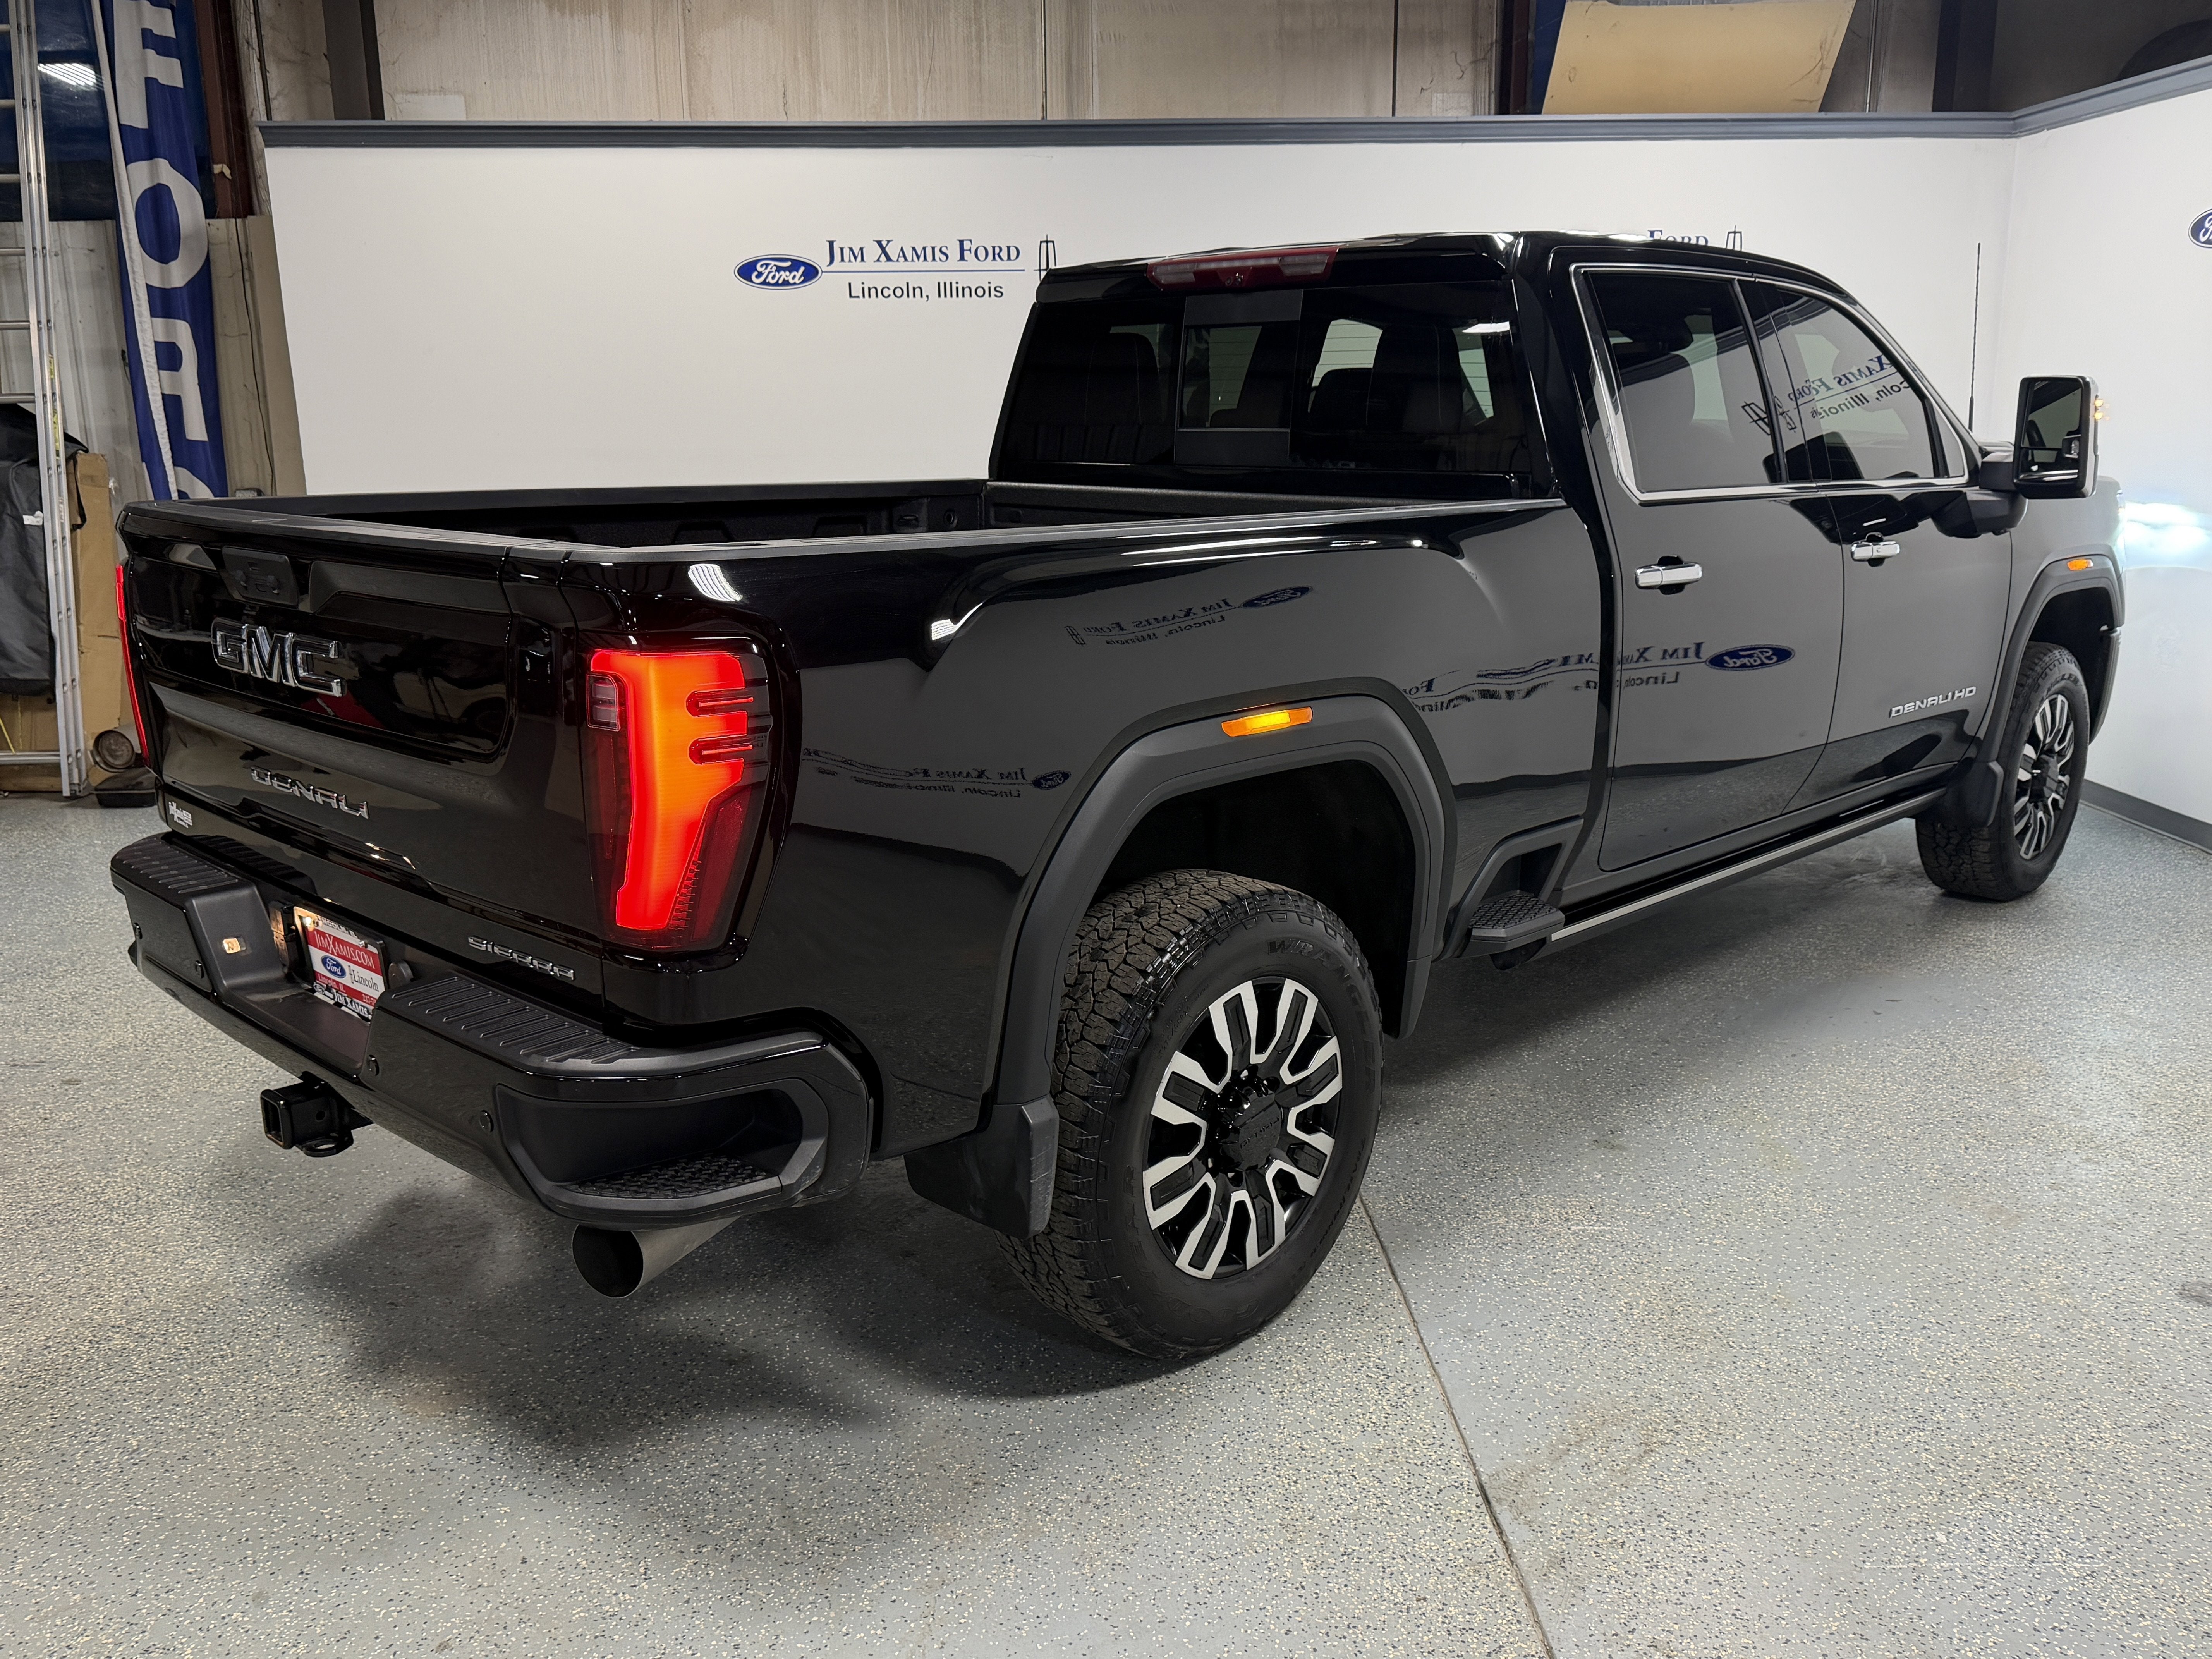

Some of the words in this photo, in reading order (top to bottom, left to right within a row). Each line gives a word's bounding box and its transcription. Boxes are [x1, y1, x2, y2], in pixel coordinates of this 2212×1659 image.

[957, 239, 1020, 262] FORD
[848, 282, 930, 302] Lincoln,
[938, 282, 1004, 298] Illinois
[211, 617, 347, 697] GMC
[1889, 692, 1952, 718] DENALI
[1953, 686, 1977, 700] HD
[251, 765, 370, 819] DENALI
[468, 935, 576, 981] SIERRA
[352, 969, 379, 992] Lincoln
